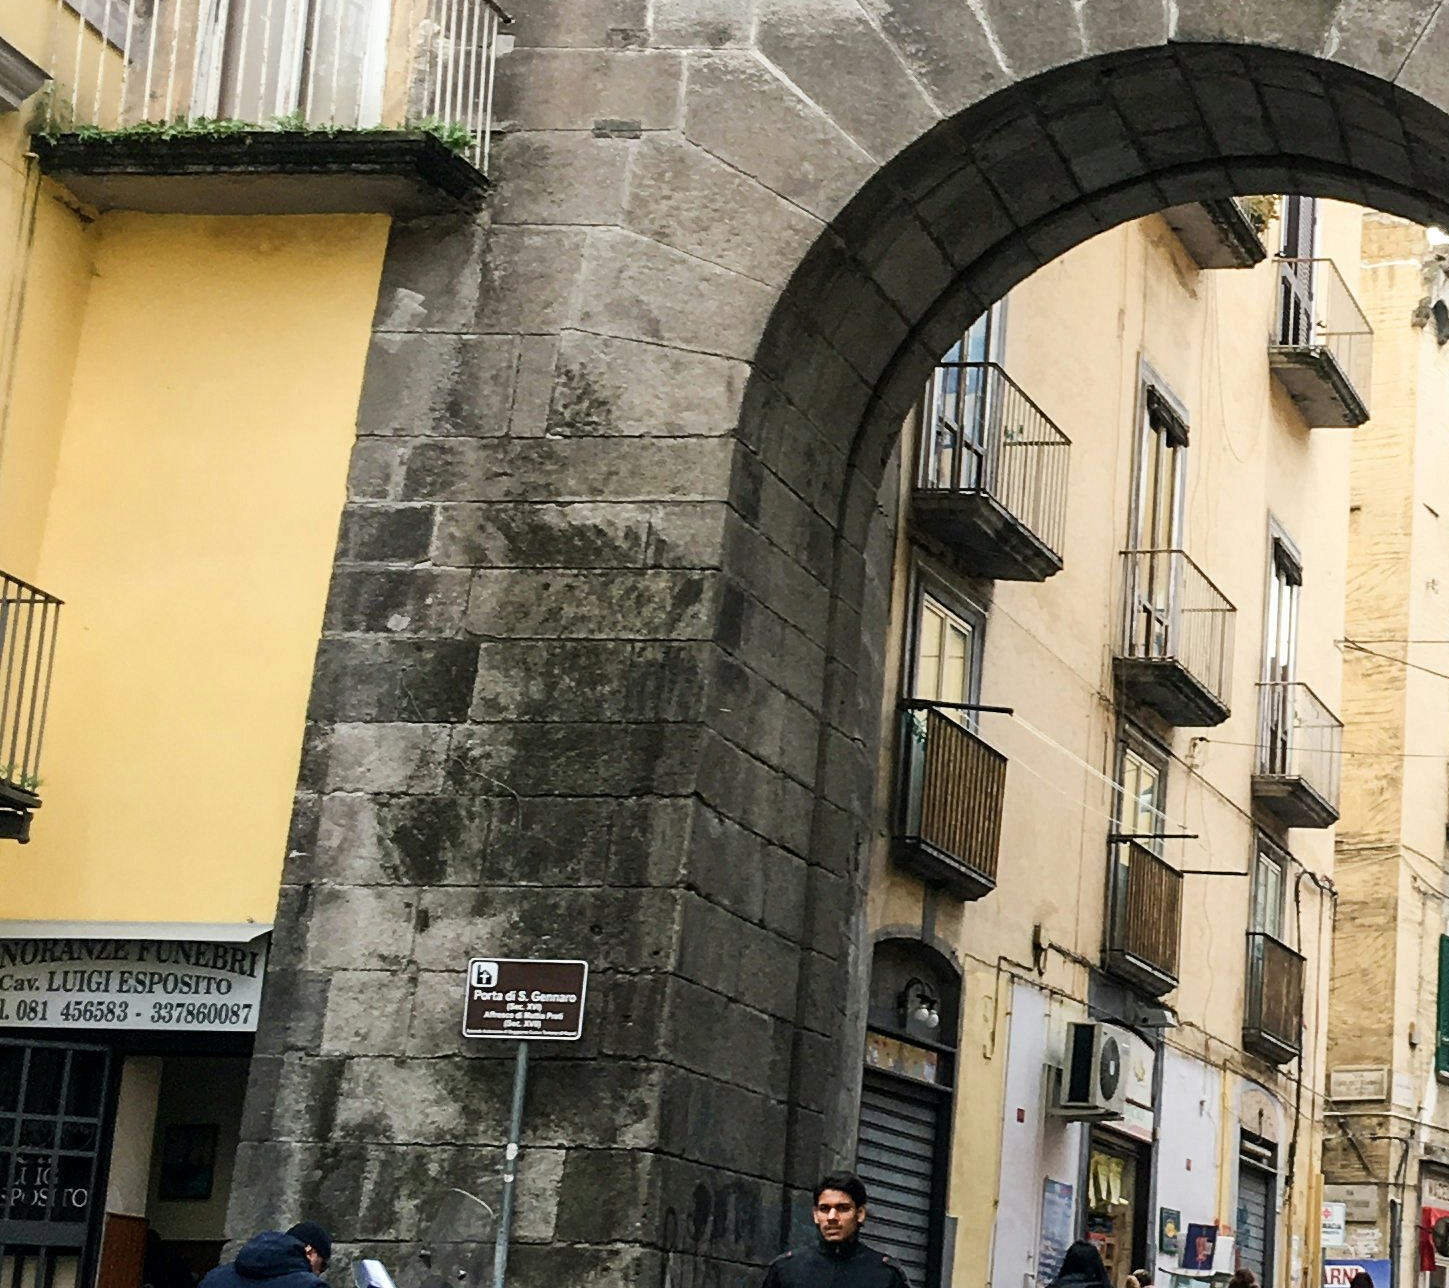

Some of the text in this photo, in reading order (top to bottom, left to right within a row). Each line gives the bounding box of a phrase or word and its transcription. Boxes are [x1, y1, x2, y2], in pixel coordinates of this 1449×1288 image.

[137, 941, 260, 978] FUNEBRI
[0, 970, 232, 995] Cav. LUIGI ESPOSITO
[473, 989, 577, 1003] Porta di S. Gennaro
[16, 999, 48, 1021] 081
[60, 1000, 129, 1022] 456583
[150, 1002, 254, 1025] 337860087
